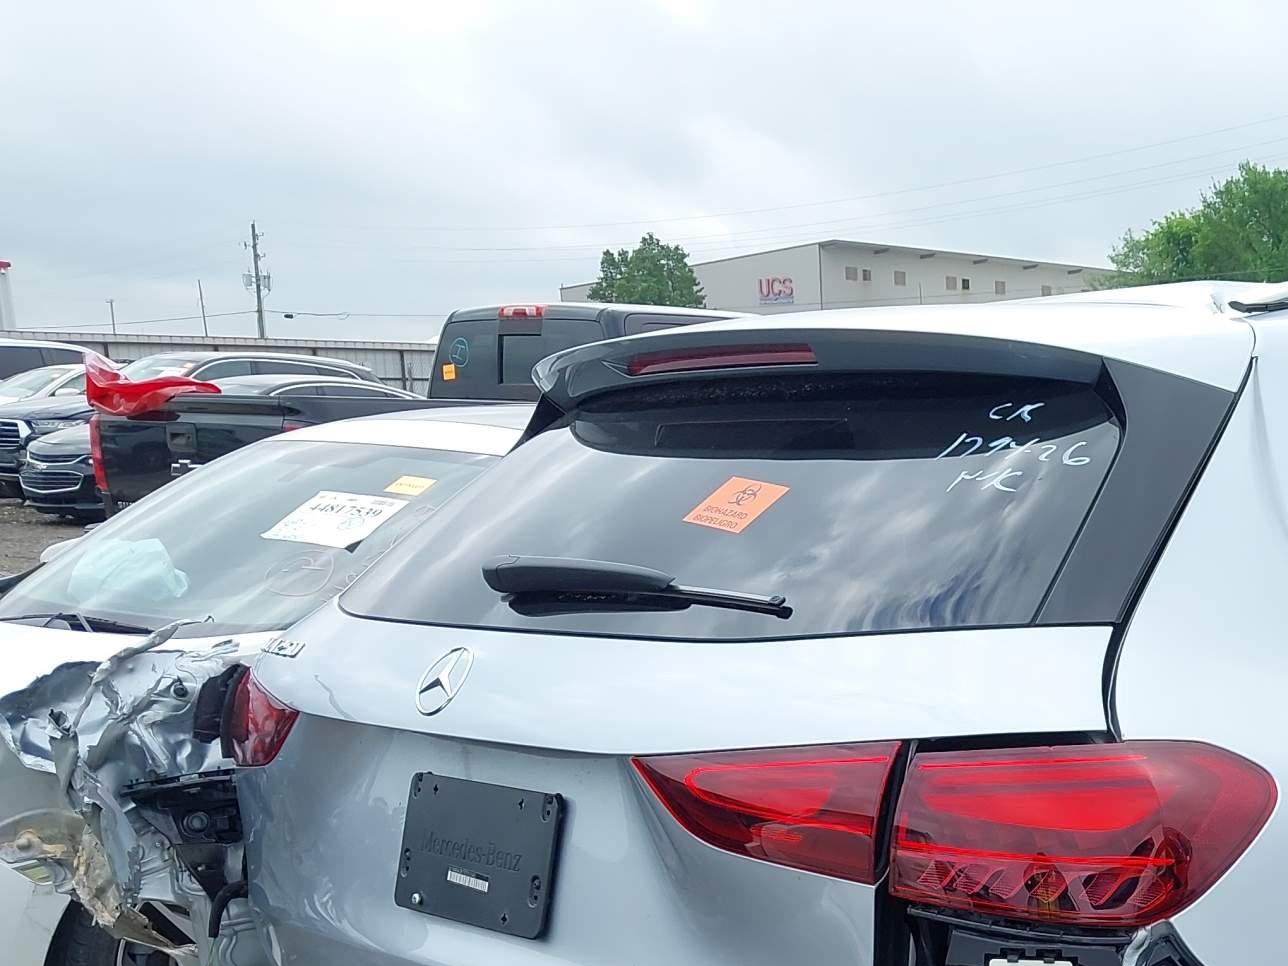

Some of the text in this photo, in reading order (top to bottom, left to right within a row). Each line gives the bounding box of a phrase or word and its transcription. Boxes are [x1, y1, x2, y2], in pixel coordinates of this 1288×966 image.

[758, 278, 794, 298] UCS
[703, 504, 749, 520] BIOHAZARD
[422, 831, 522, 872] Mercedes-Benz
